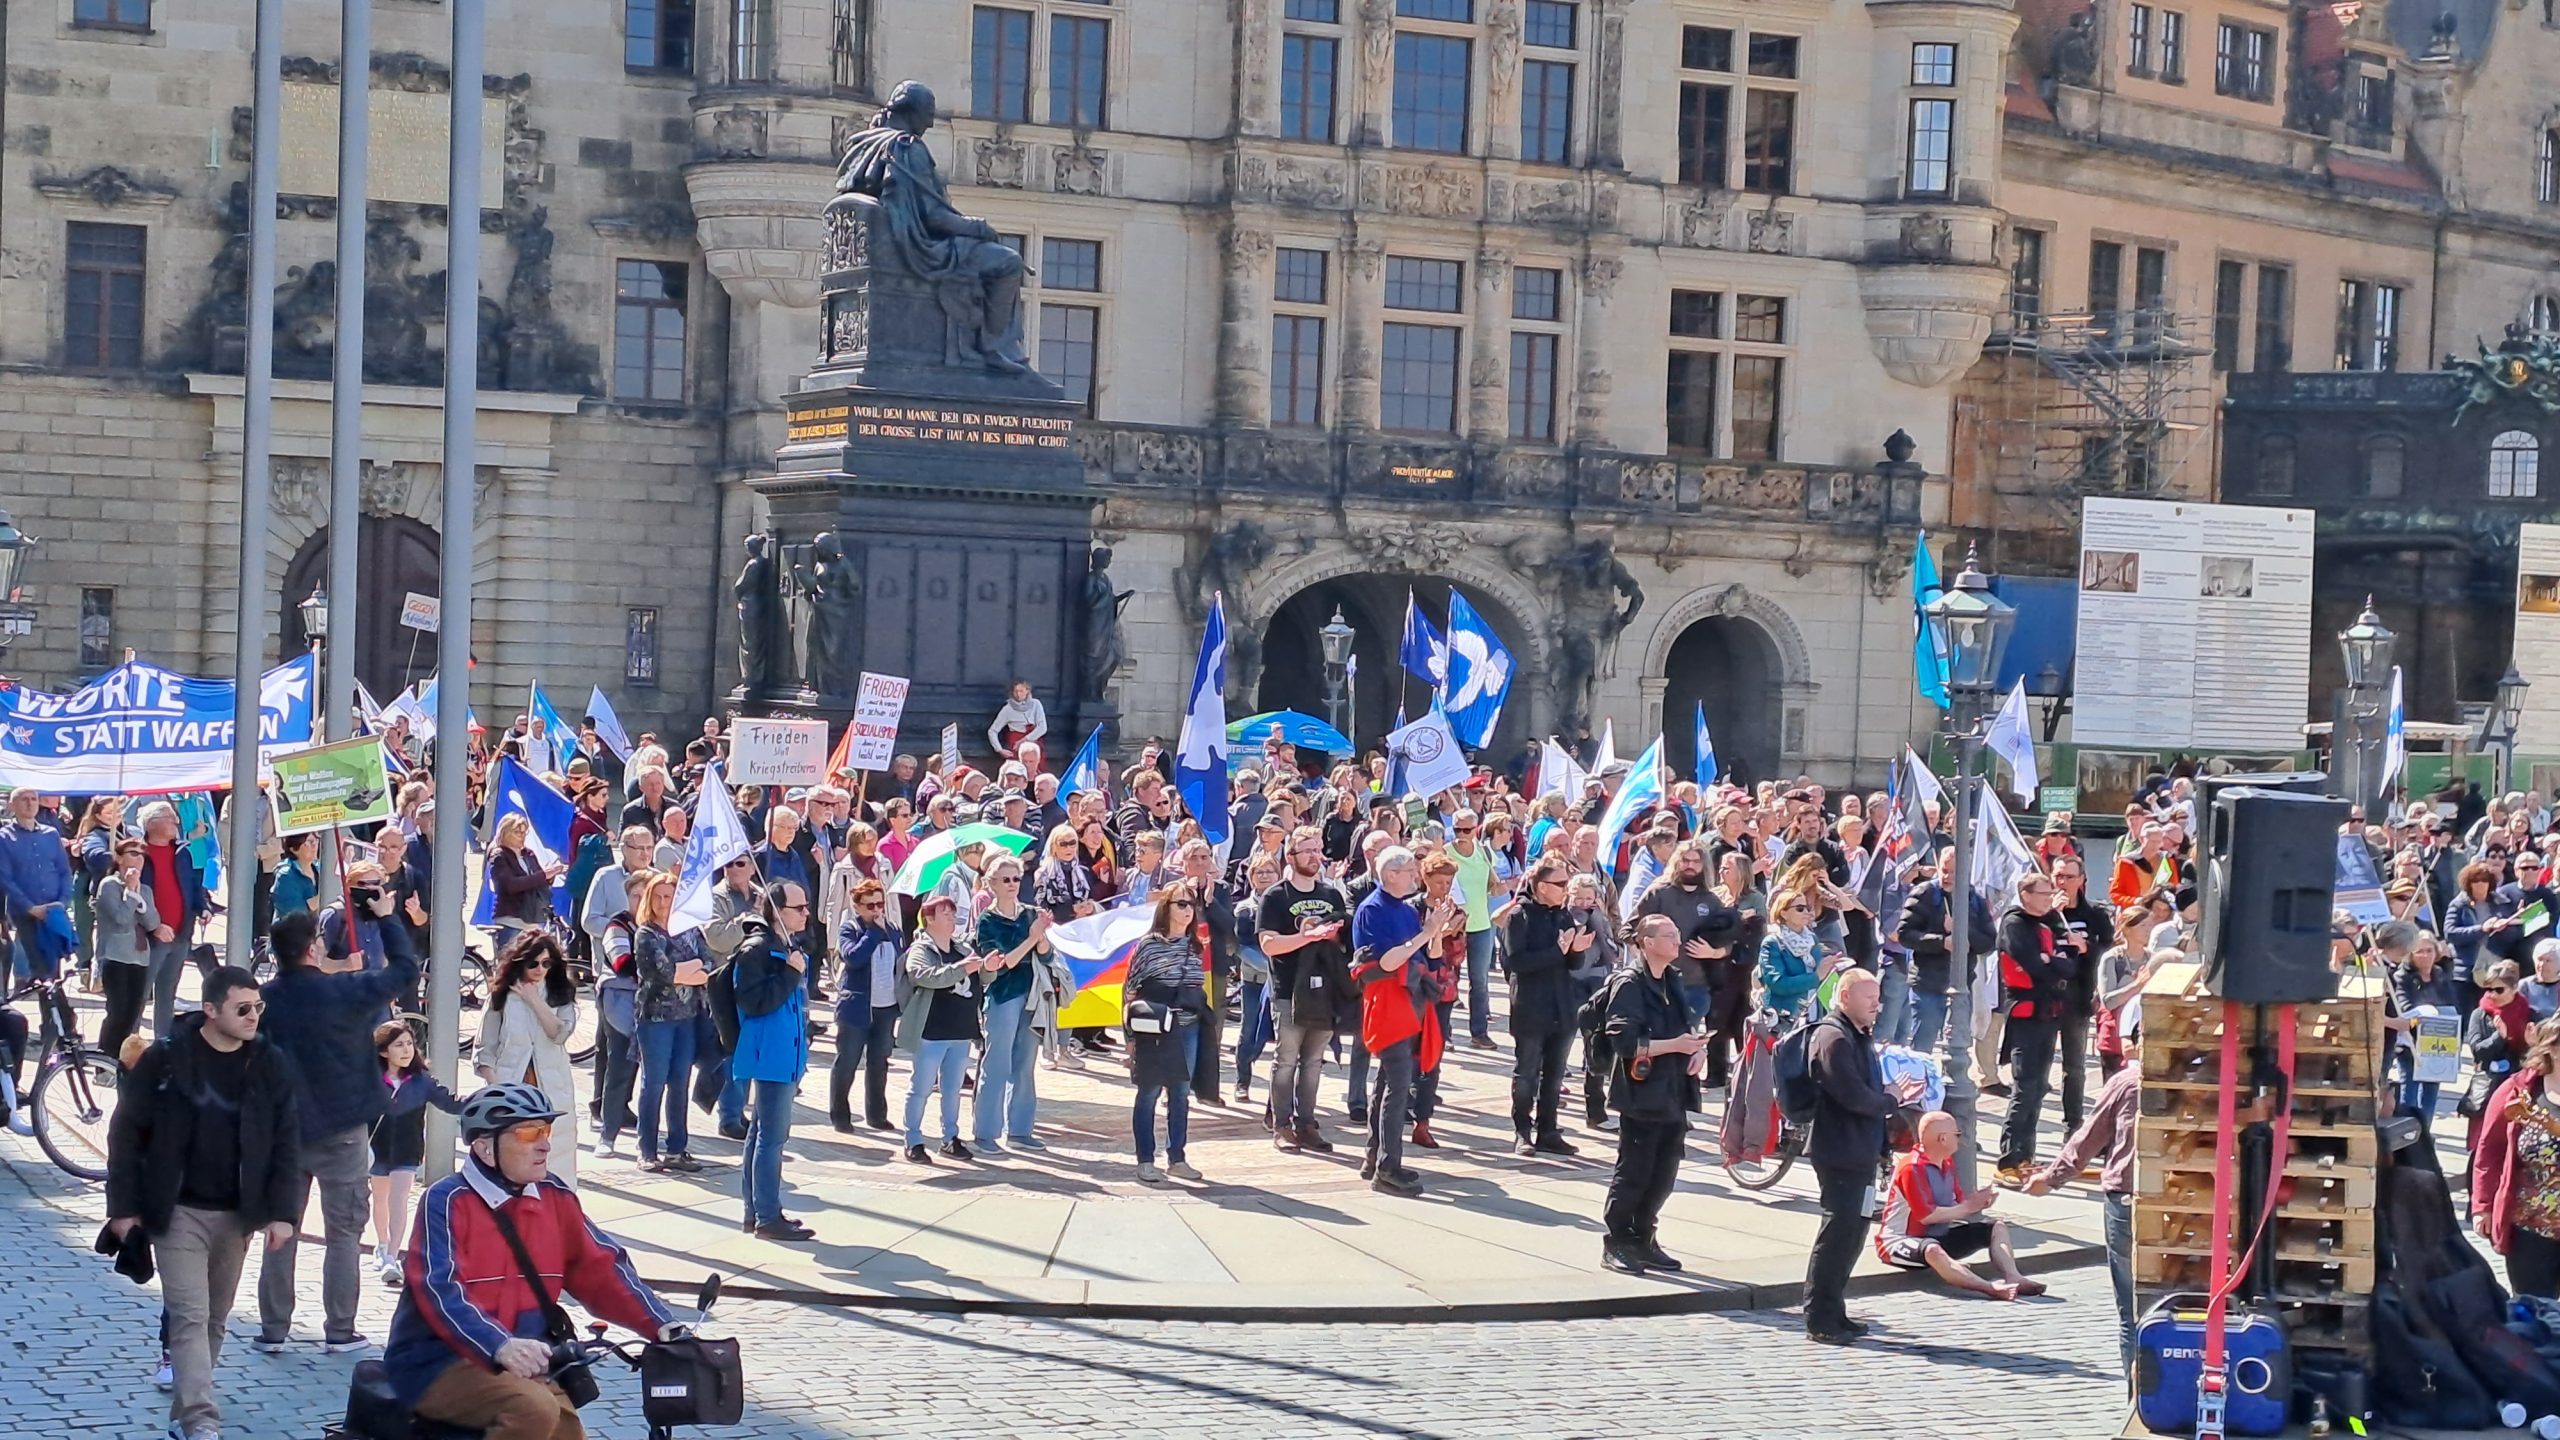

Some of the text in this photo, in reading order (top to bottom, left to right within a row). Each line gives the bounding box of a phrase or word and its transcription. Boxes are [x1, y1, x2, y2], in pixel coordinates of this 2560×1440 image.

[854, 406, 881, 418] WOHL
[883, 408, 902, 419] DEM
[906, 409, 937, 422] MANNE
[941, 411, 959, 423] DER
[963, 413, 980, 425] DEN
[984, 414, 1018, 427] EWIGEN
[859, 423, 877, 435] DER
[880, 425, 915, 438] GROSSE
[919, 428, 943, 440] LUST
[946, 429, 965, 441] HAT
[966, 430, 980, 442] AN
[983, 431, 1000, 444] DES
[1004, 432, 1035, 446] HERRN
[17, 663, 186, 718] WORTE
[863, 677, 909, 699] FRIEDEN
[54, 712, 280, 753] STATT WAFFN
[750, 726, 809, 745] Frieden
[749, 760, 816, 780] Kriegstreiberei
